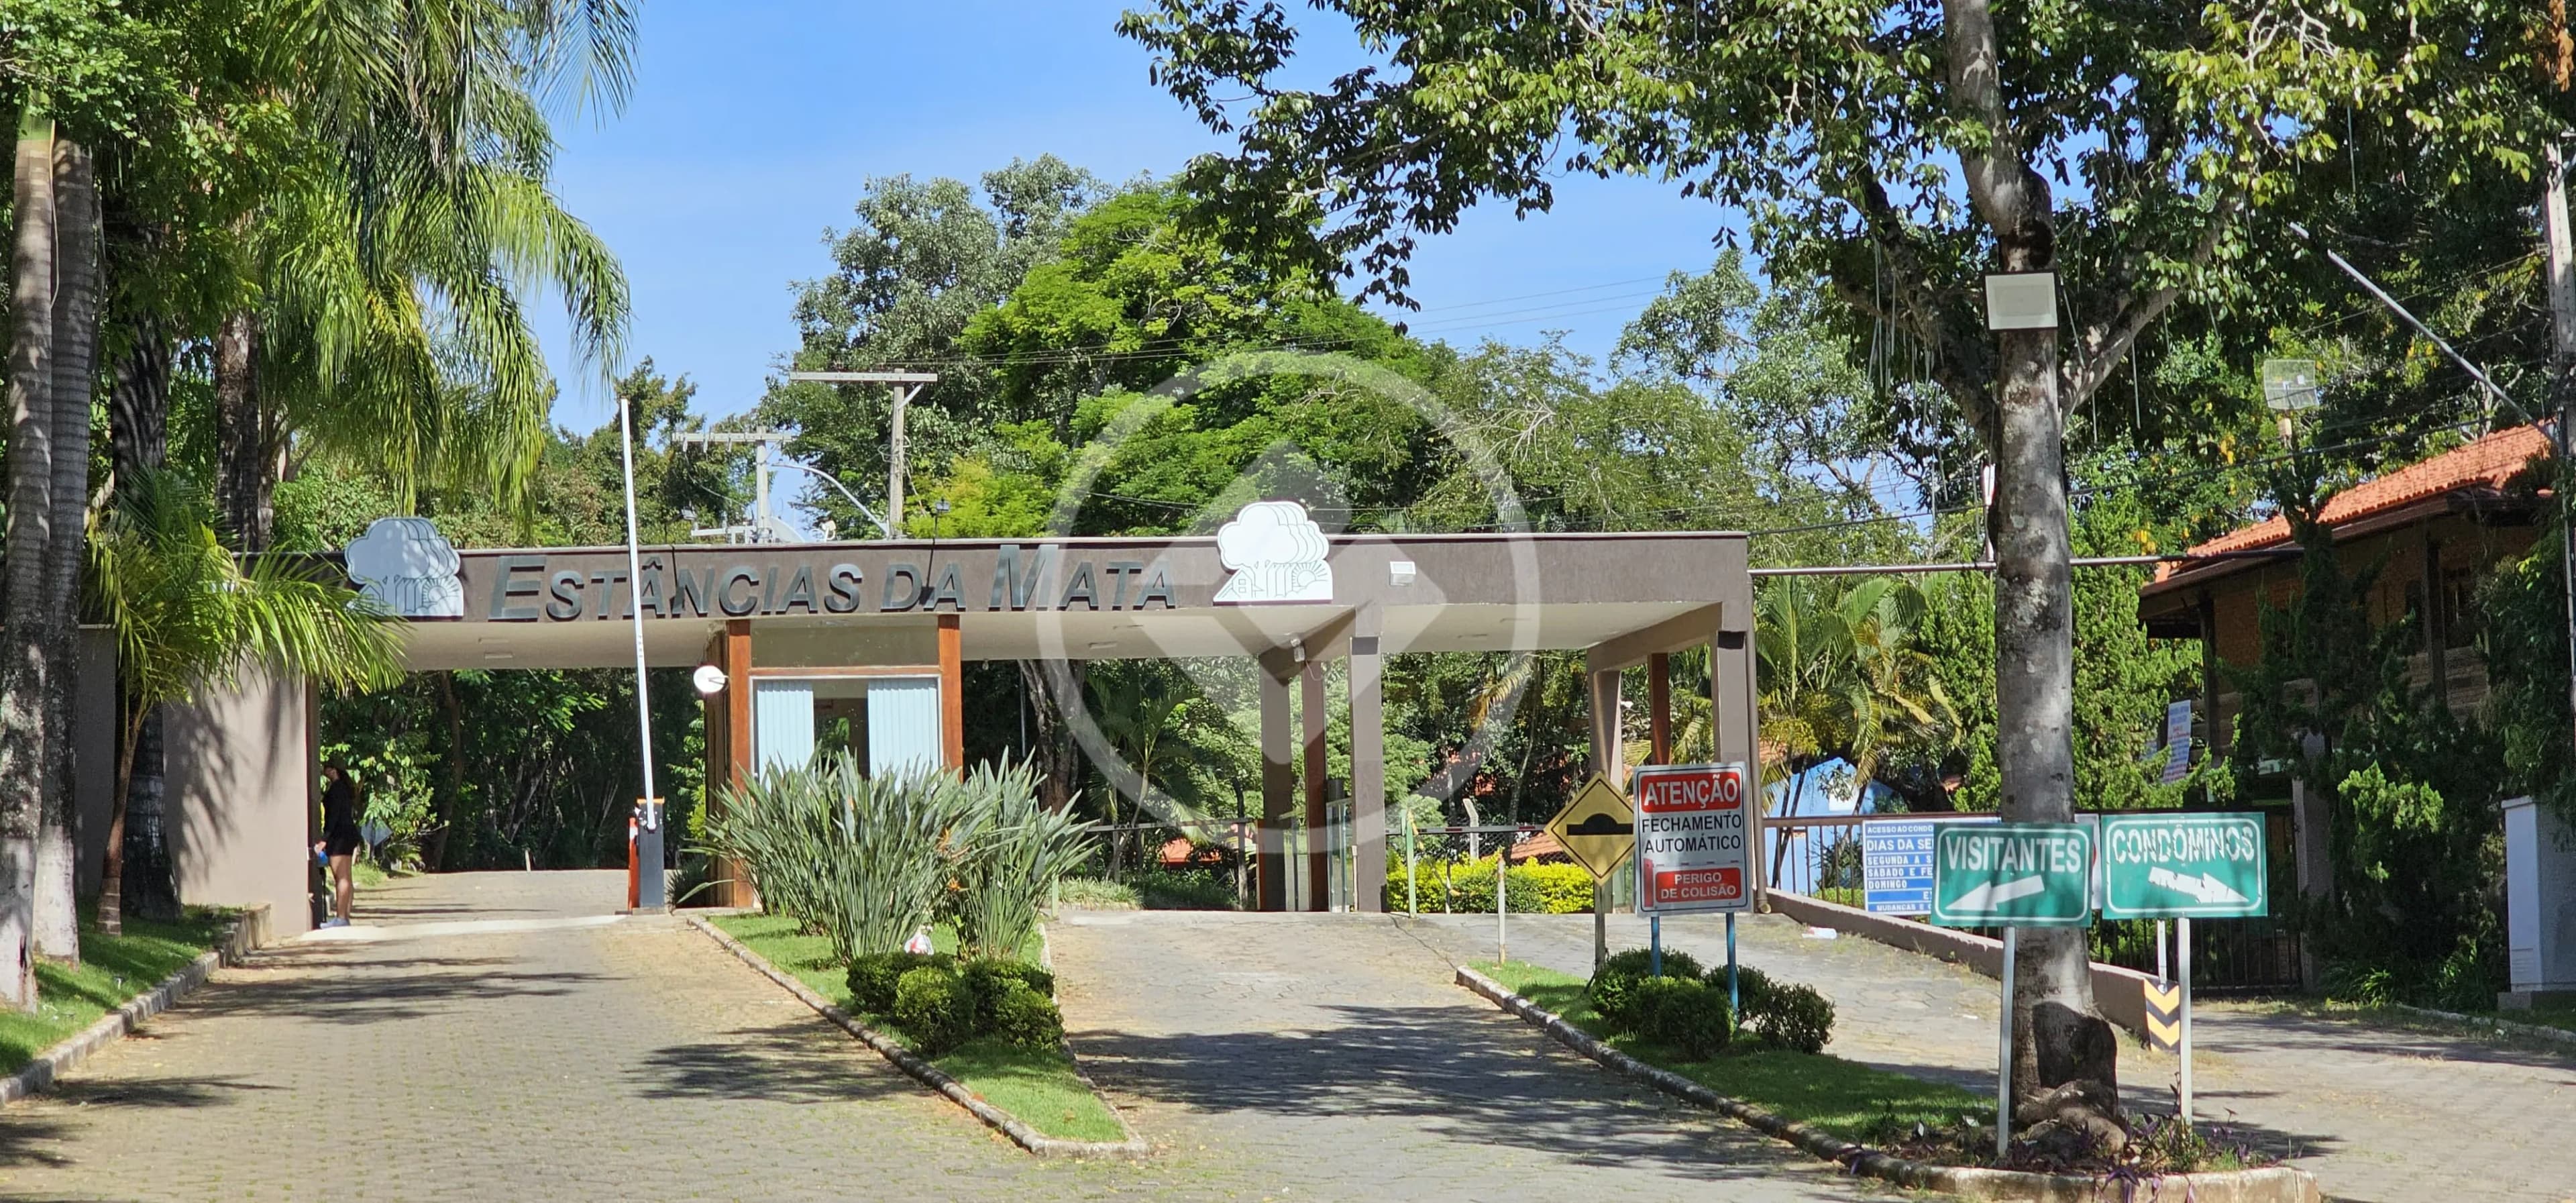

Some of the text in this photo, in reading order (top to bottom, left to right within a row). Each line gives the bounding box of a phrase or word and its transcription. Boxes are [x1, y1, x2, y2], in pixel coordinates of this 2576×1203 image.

[880, 562, 967, 612] DA
[988, 543, 1177, 611] MATA
[1644, 774, 1737, 808] ATENÇÃO
[1642, 814, 1741, 833] FECHAMENTO
[1644, 832, 1741, 853] AUTOMÁTICO
[1867, 838, 1934, 851] DIAS DA SE
[2112, 824, 2255, 864] CONDÔMINOS
[1867, 855, 1909, 866] SEGUNDA
[1915, 855, 1919, 864] A
[1946, 836, 2080, 872] VISITANTES
[1674, 872, 1721, 884] PERIGO
[1909, 867, 1915, 876] E
[1661, 884, 1736, 899] DE COLISÃO
[1868, 880, 1907, 889] DOMINGO
